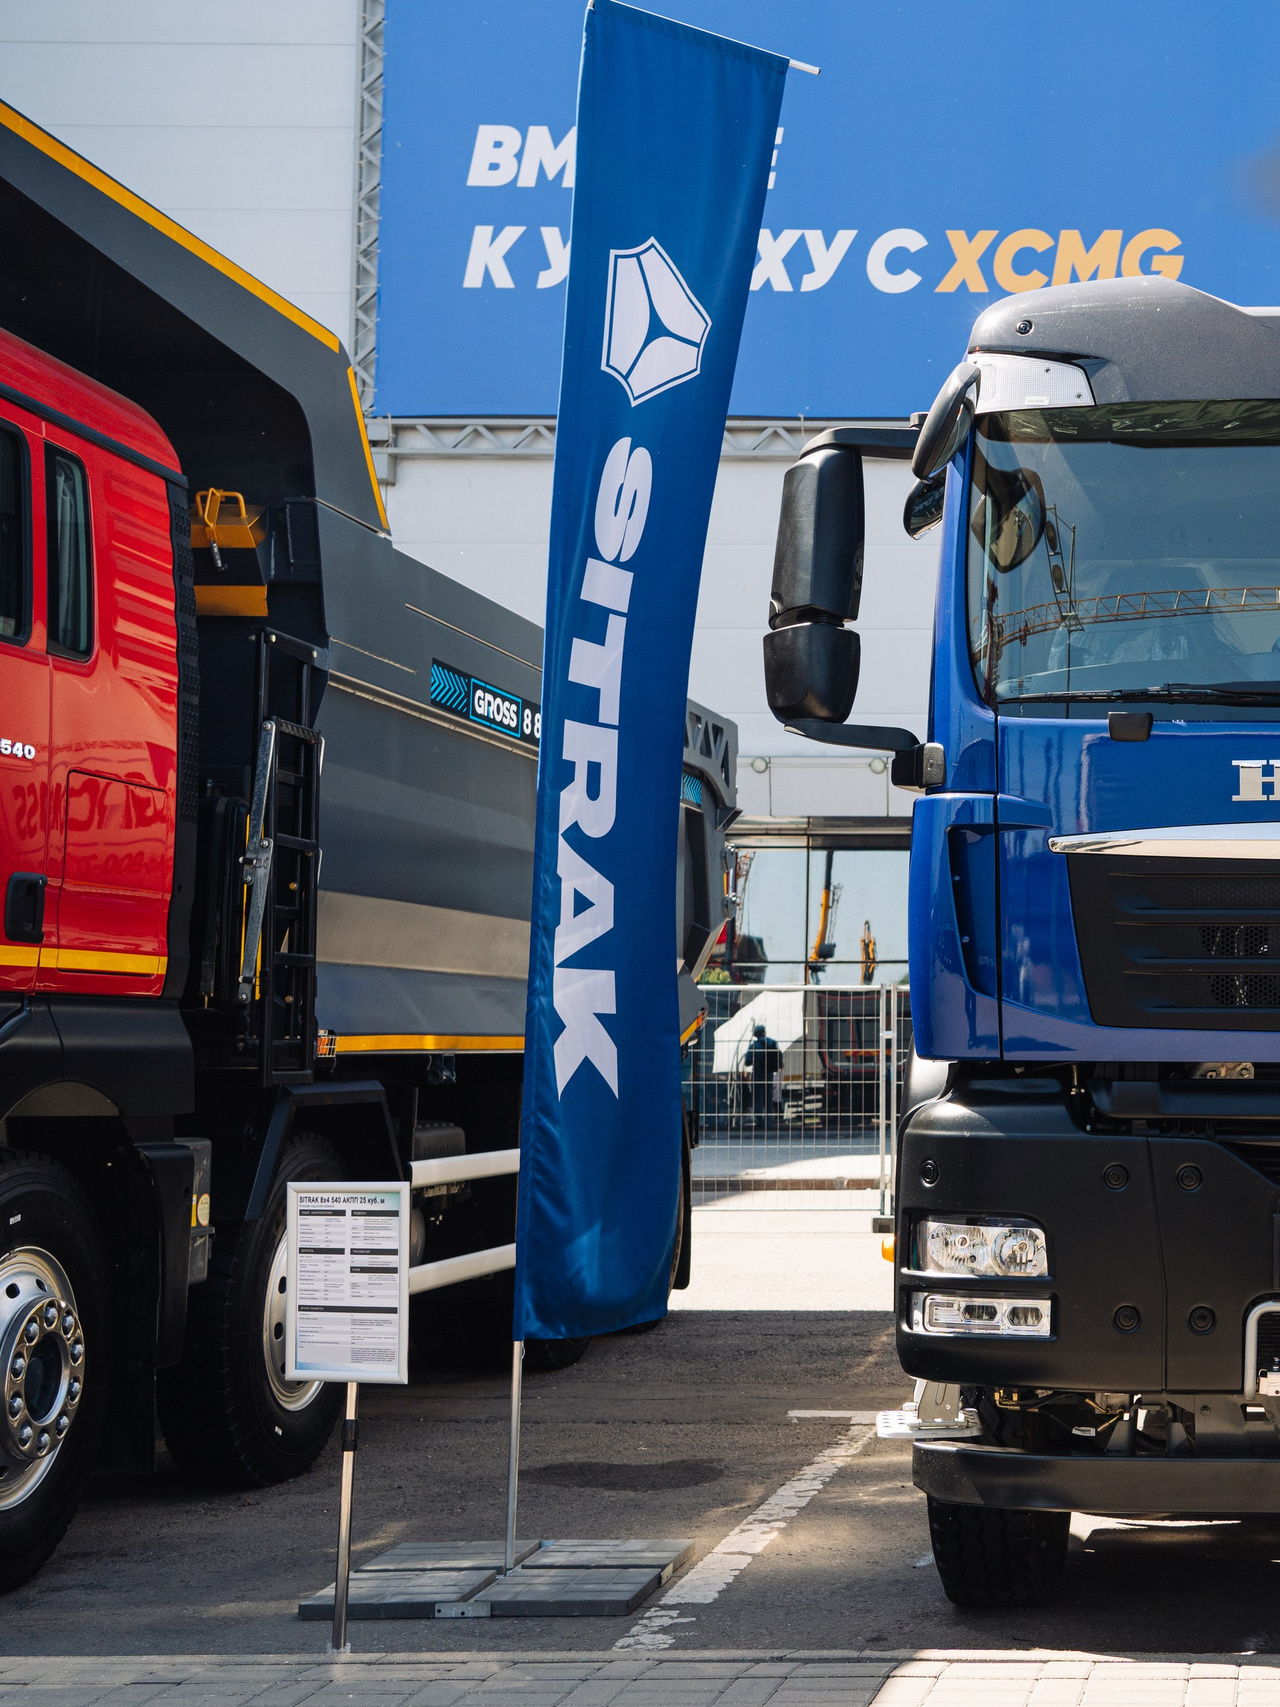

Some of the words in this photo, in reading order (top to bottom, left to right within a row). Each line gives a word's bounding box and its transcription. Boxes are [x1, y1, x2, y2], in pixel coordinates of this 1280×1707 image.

[463, 225, 527, 288] К
[866, 228, 928, 294] С
[934, 228, 1184, 293] XCMG
[474, 689, 517, 728] GROSS
[0, 738, 35, 760] 540
[553, 436, 652, 1102] SITRAK
